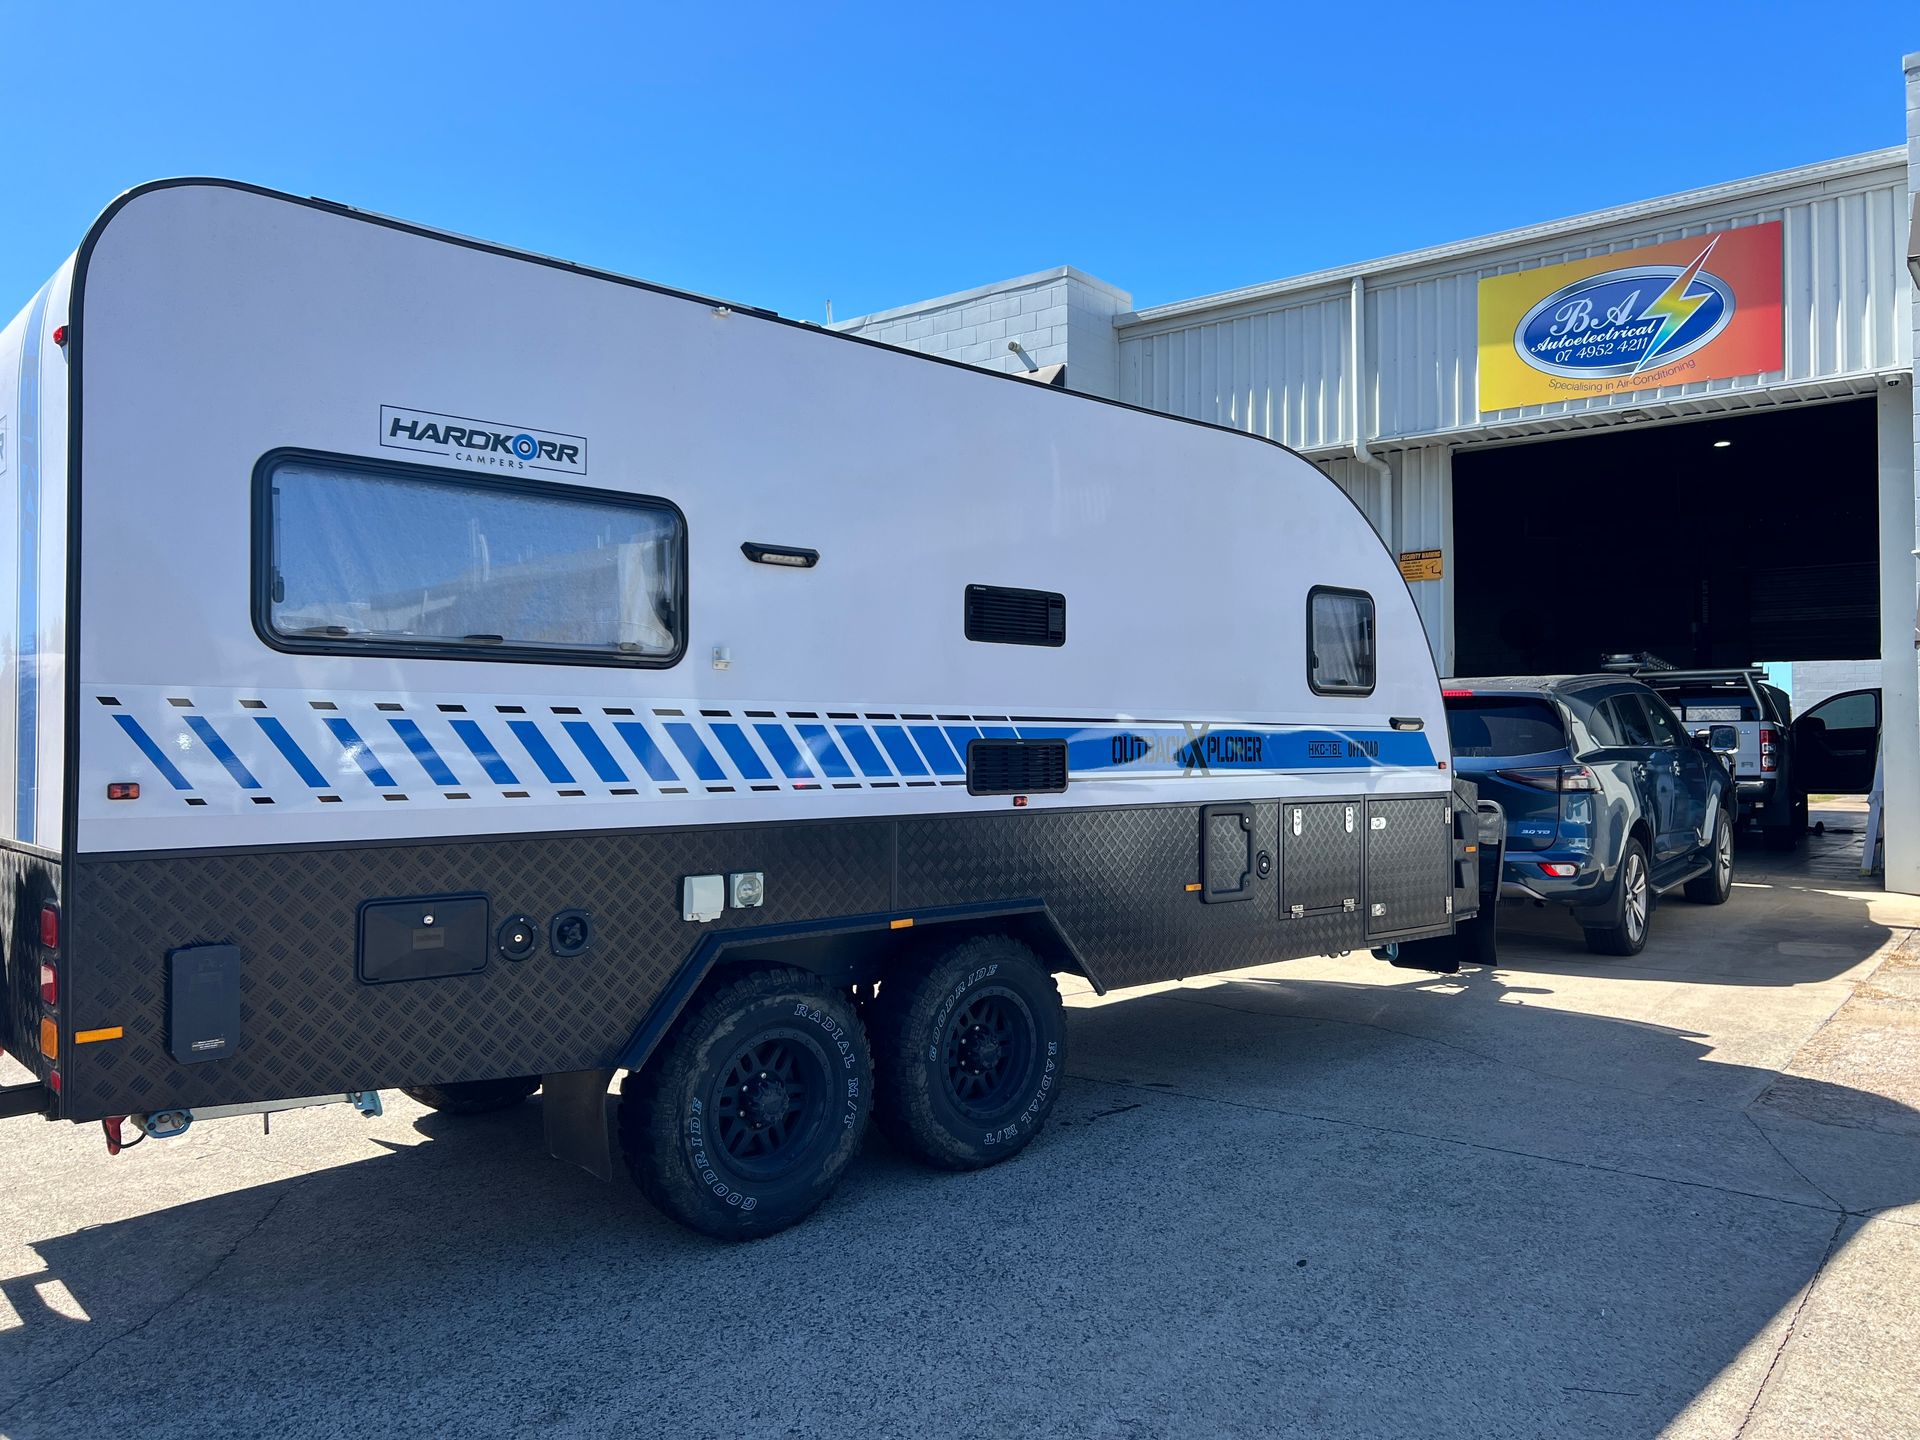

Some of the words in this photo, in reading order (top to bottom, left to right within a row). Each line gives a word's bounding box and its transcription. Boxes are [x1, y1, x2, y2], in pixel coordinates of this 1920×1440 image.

[1531, 320, 1655, 353] Autoelectrical
[1555, 348, 1573, 363] 07
[1576, 342, 1615, 359] 4952
[1616, 336, 1648, 353] 4211
[1548, 378, 1603, 393] Specialising
[1605, 381, 1614, 390] in
[1616, 358, 1696, 389] Air-Conditioning
[389, 417, 580, 465] HARDKORR
[455, 452, 524, 470] CAMPERS
[1111, 735, 1188, 764] OUTBACK
[1347, 740, 1379, 758] OFFROAD
[929, 964, 998, 1062] GOODRIDE
[794, 1003, 856, 1069] RADIAL
[843, 1077, 859, 1129] M/T
[1020, 1041, 1057, 1125] RADIAL
[984, 1123, 1018, 1145] M/T
[691, 1097, 758, 1211] GOODRIDE
